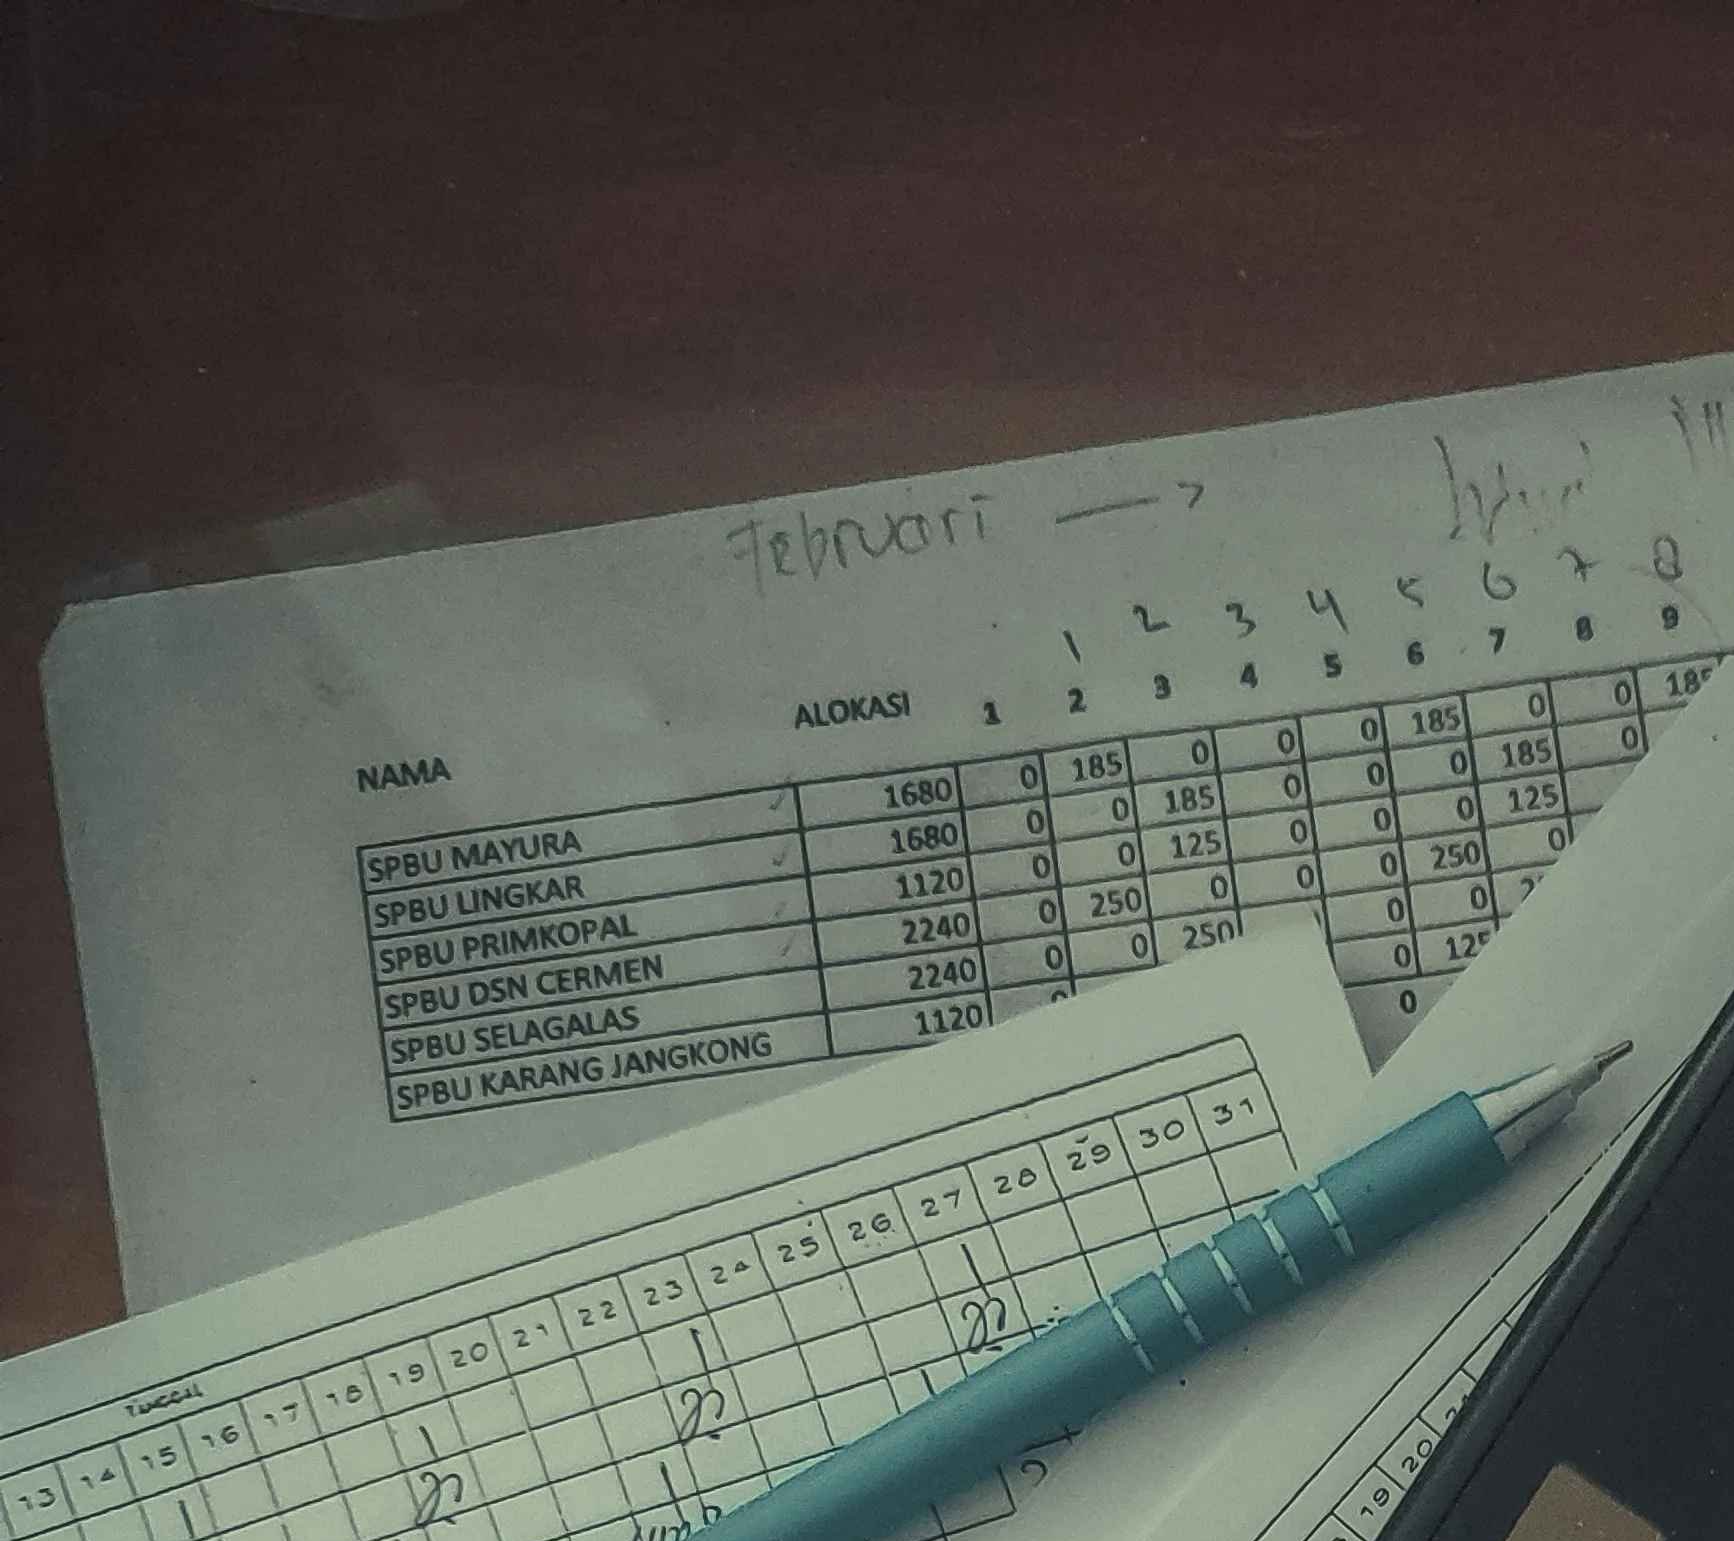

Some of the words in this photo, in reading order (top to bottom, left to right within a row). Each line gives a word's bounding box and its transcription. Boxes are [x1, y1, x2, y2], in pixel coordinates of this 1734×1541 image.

[983, 700, 1002, 726] 1
[1068, 687, 1087, 714] 2
[1240, 661, 1258, 689] 4
[1323, 649, 1343, 678] 5
[1406, 640, 1425, 667] 6
[1488, 626, 1506, 655] 7
[794, 690, 910, 730] ALOKASI
[356, 757, 452, 793] NAMA
[884, 777, 952, 809] 1680
[367, 849, 442, 882] SPBU
[451, 829, 582, 870] MAYURA
[890, 822, 958, 854] 1680
[374, 894, 448, 928] SPBU
[456, 875, 586, 915] LINGKAR
[896, 867, 964, 900] 1120
[379, 939, 454, 974] SPBU
[462, 913, 639, 961] PRIMKOPAL
[902, 913, 970, 945] 2240
[384, 985, 460, 1019] SPBU
[468, 974, 528, 1006] DSN
[536, 954, 663, 995] CERMEN
[908, 956, 976, 990] 2240
[391, 1030, 466, 1064] SPBU
[474, 1005, 640, 1052] SELAGALAS
[915, 1002, 983, 1036] 1120
[396, 1076, 472, 1110] SPBU
[480, 1056, 603, 1097] KARANG
[611, 1031, 772, 1079] JANGKONG
[17, 1488, 56, 1510] 13
[139, 1446, 177, 1469] 15
[201, 1425, 239, 1447] 16
[263, 1402, 298, 1427] 17
[326, 1384, 363, 1406] 18
[388, 1363, 424, 1386] 19
[450, 1342, 488, 1368] 20
[512, 1323, 548, 1348] 21
[578, 1300, 617, 1327] 22
[643, 1280, 683, 1306] 23
[777, 1235, 819, 1263] 25
[847, 1212, 896, 1247] 26
[920, 1188, 960, 1217] 27
[993, 1167, 1037, 1195] 28
[1066, 1143, 1111, 1171] 29
[1139, 1118, 1184, 1149] 30
[1212, 1097, 1253, 1126] 31
[1360, 1487, 1389, 1516] 19
[1401, 1439, 1431, 1472] 20
